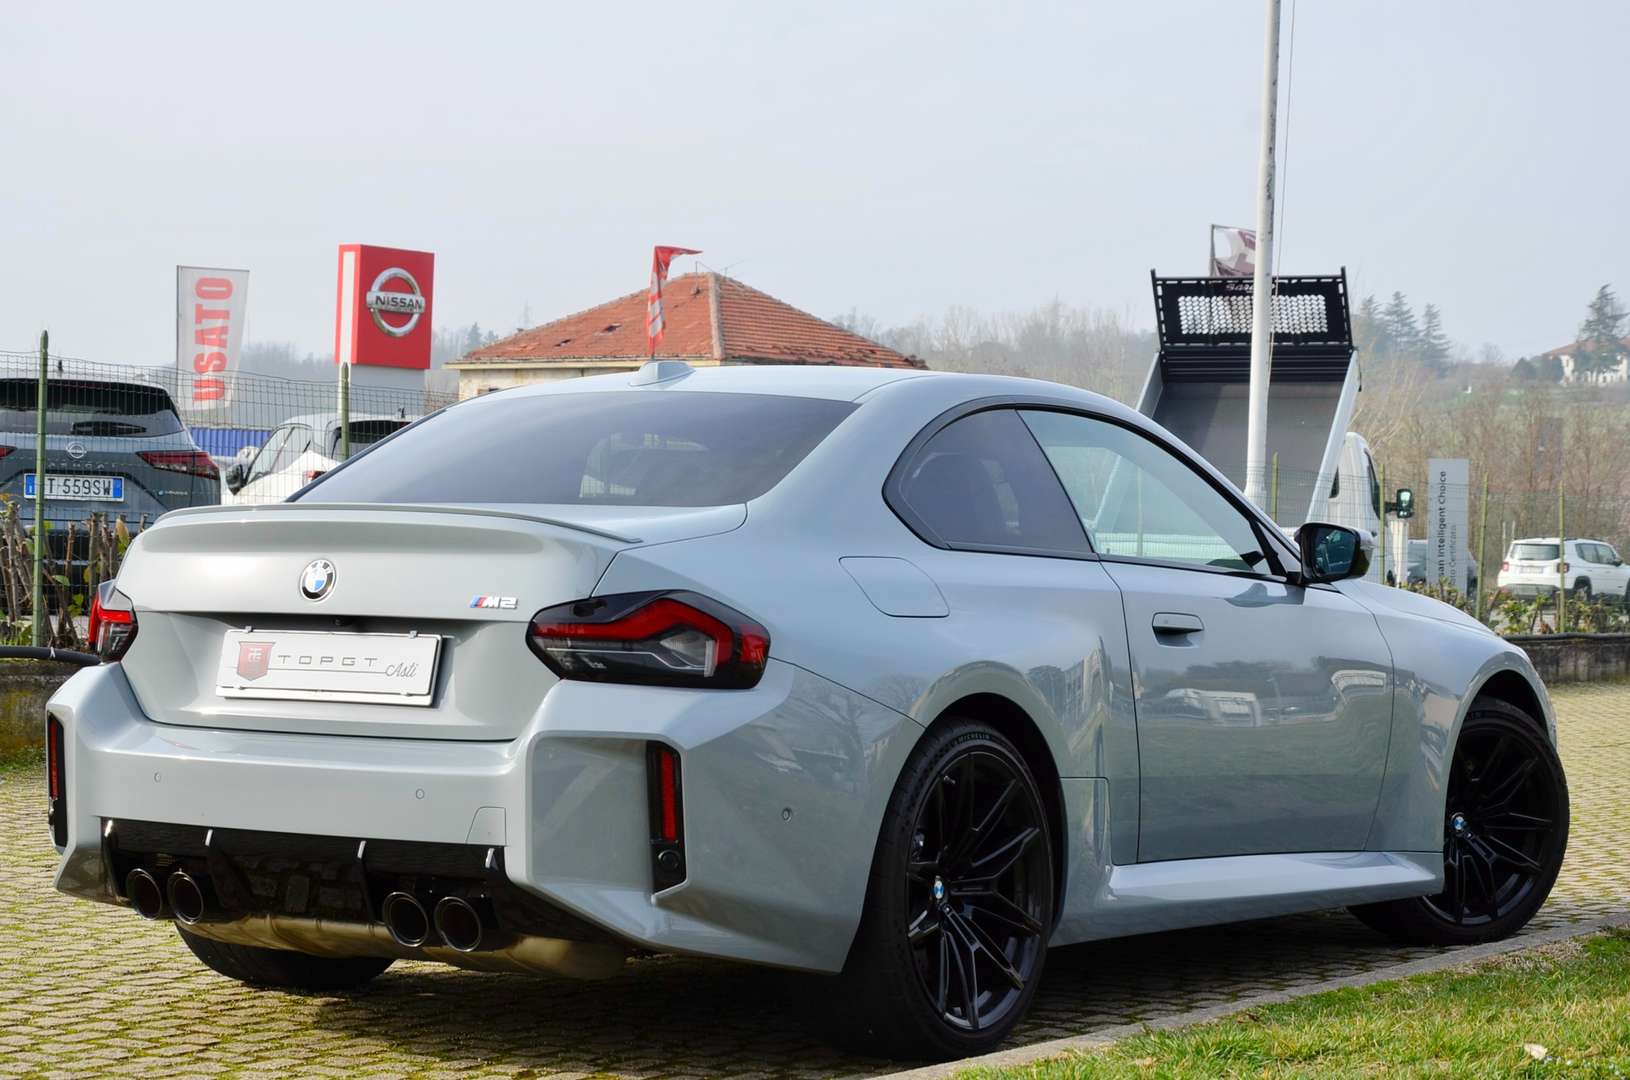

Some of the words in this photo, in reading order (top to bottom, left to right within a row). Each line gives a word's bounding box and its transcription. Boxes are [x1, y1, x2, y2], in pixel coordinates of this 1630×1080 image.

[375, 295, 423, 310] NISSAN
[192, 277, 233, 402] USATO
[63, 478, 112, 496] 559SW
[1437, 471, 1447, 505] Choice
[1437, 506, 1447, 559] Intelligent
[1438, 559, 1446, 577] san
[478, 596, 518, 609] M2
[277, 654, 378, 667] TOPGT
[385, 662, 418, 678] Asti
